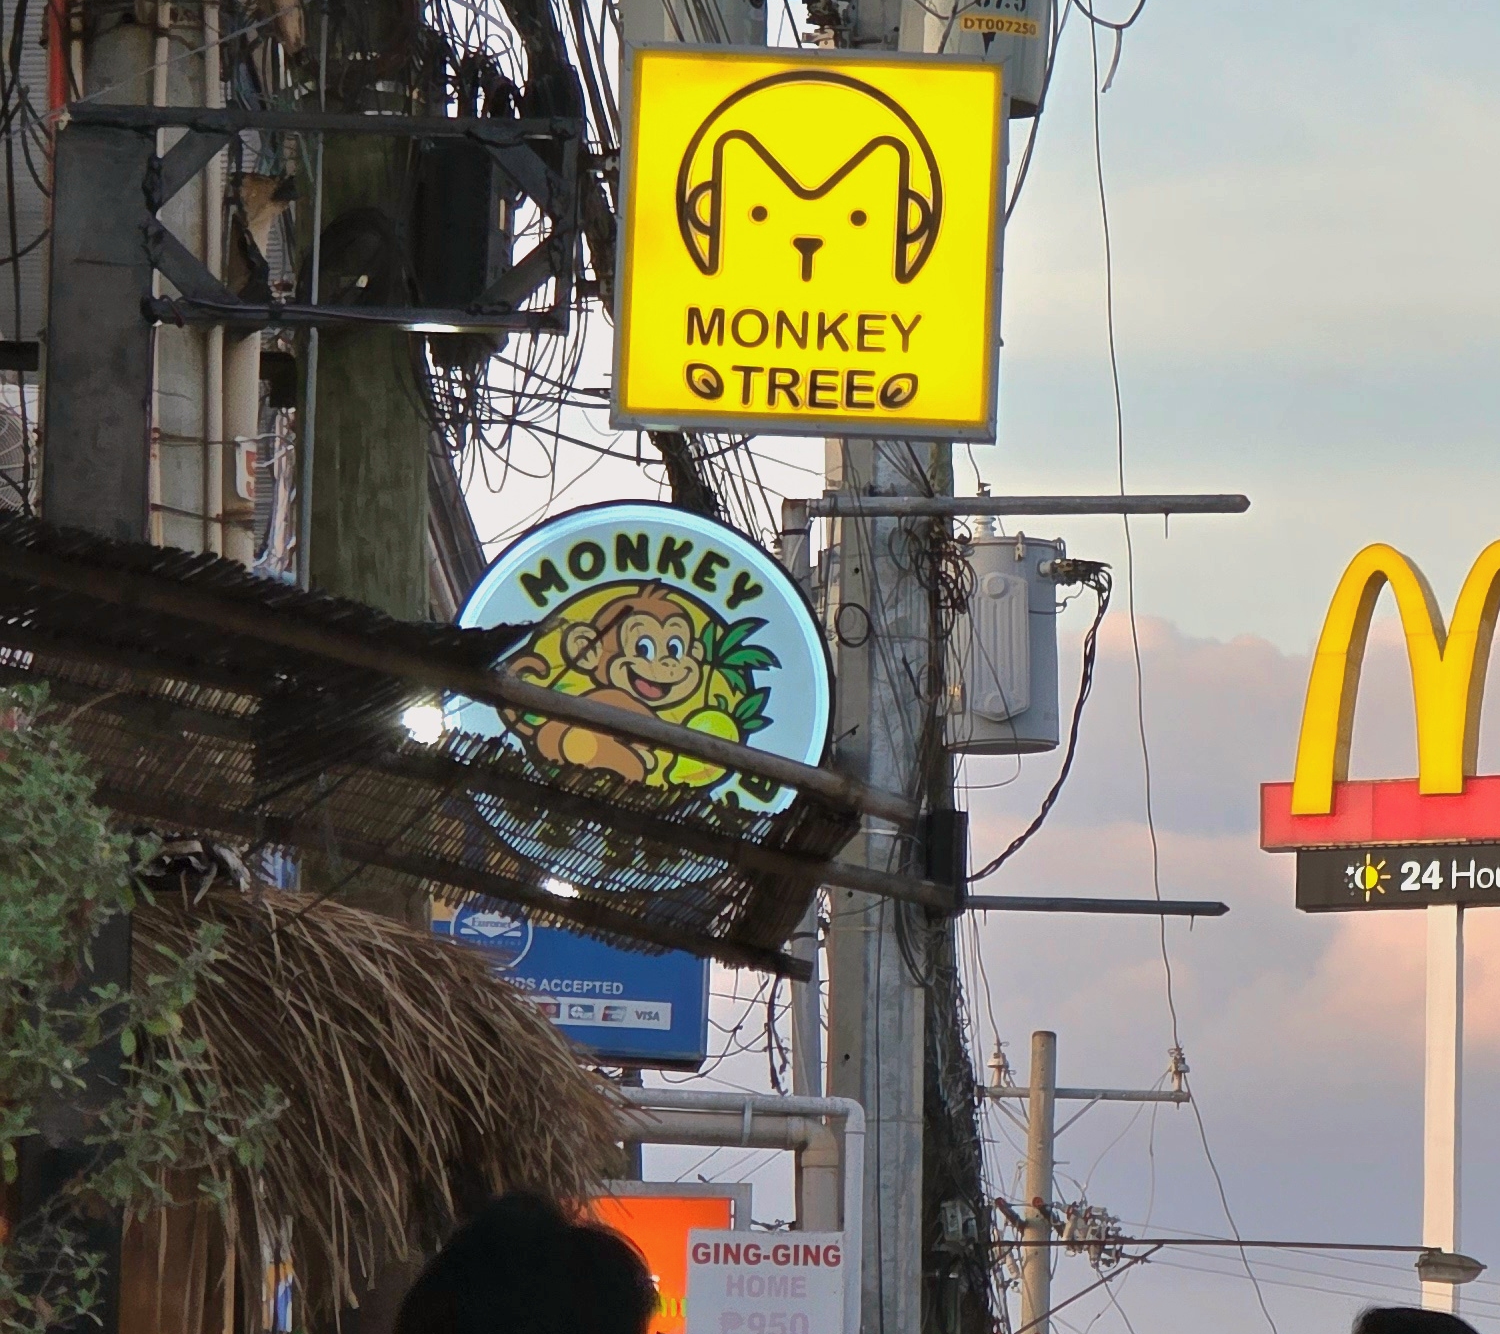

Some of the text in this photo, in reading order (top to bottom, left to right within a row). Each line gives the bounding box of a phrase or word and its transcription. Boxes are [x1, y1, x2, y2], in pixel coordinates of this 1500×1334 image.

[686, 307, 923, 353] MONKEY
[731, 365, 876, 410] TREE
[519, 532, 764, 611] MONKEY
[1400, 860, 1443, 891] 24
[538, 978, 624, 995] ACCEPTED
[634, 1010, 660, 1021] VISA
[691, 1242, 841, 1267] GING-GING
[726, 1275, 807, 1299] HOME
